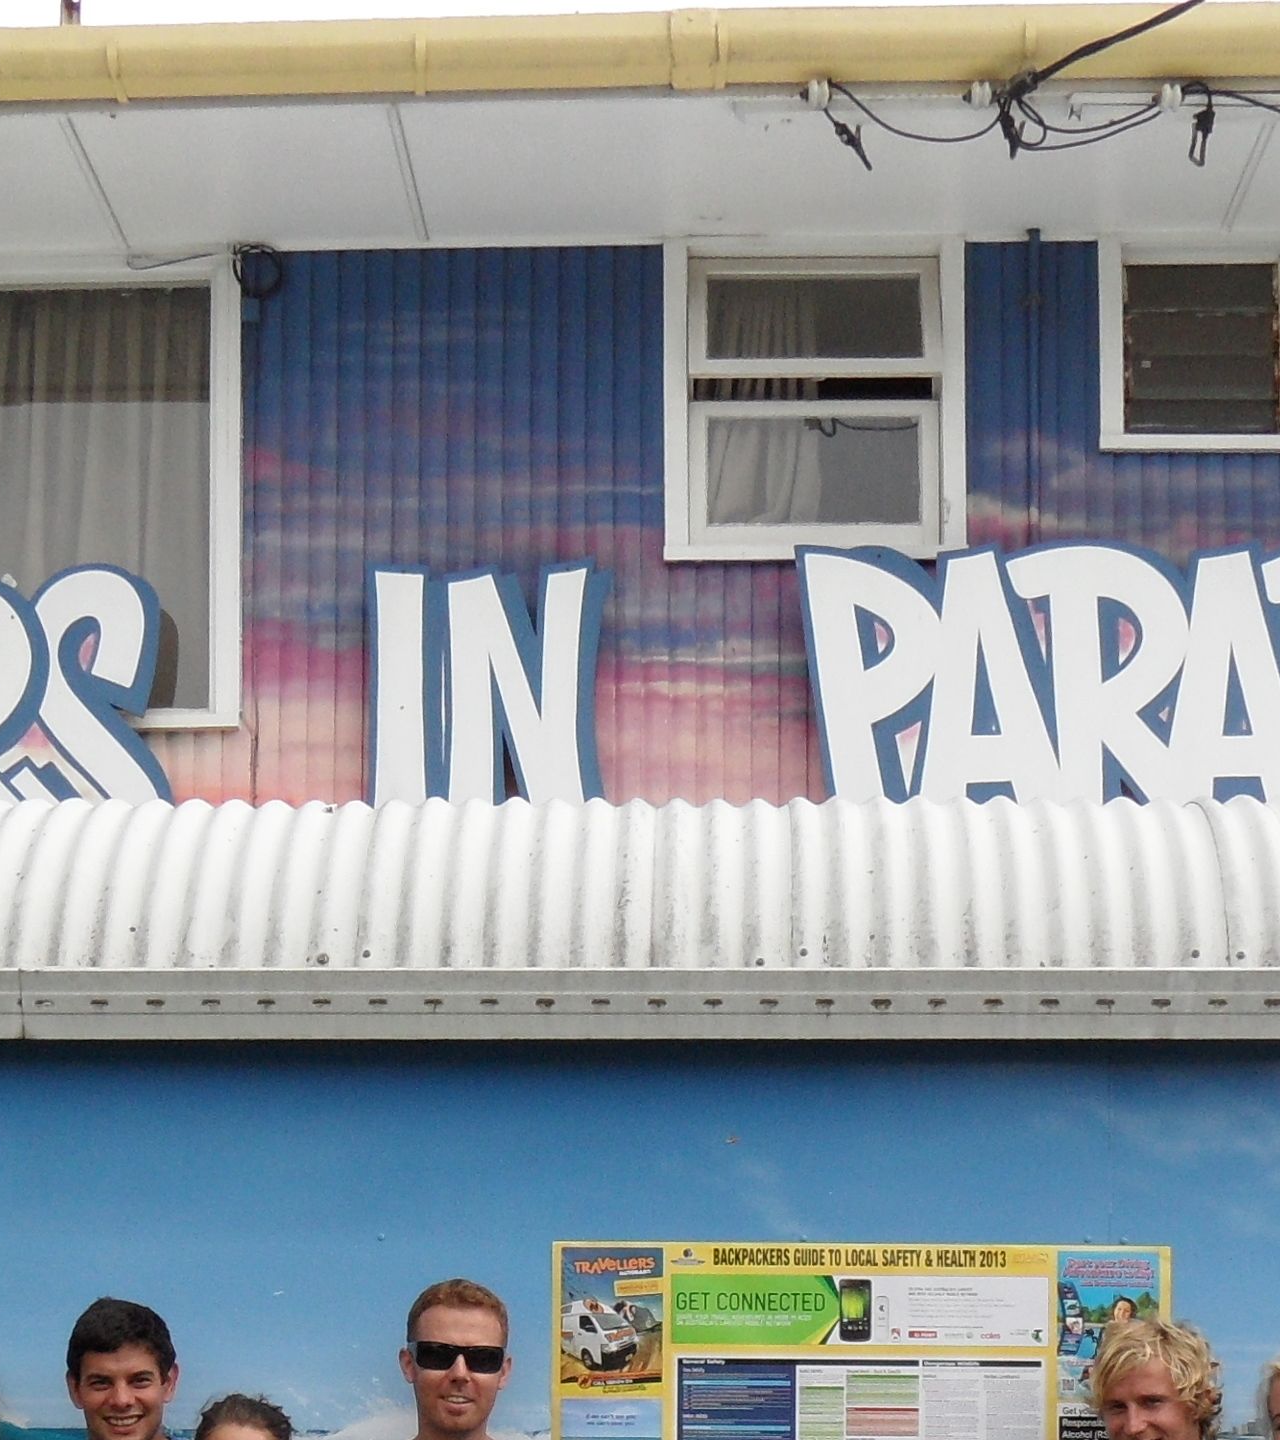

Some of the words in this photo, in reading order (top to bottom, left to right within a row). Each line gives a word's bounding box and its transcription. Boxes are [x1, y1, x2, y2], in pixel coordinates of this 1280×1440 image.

[375, 567, 587, 806] IN
[712, 1247, 790, 1267] BACKPACKERS
[793, 1249, 826, 1267] GUIDE
[829, 1249, 842, 1267] TO
[845, 1249, 879, 1267] LOCAL
[881, 1249, 922, 1268] SAFETY
[924, 1250, 933, 1268] &
[936, 1250, 977, 1268] HEALTH
[978, 1250, 1007, 1268] 2013
[675, 1292, 710, 1311] GET
[716, 1292, 826, 1312] CONNECTED
[1061, 1418, 1104, 1429] Responsib
[1061, 1431, 1093, 1440] Alcohol
